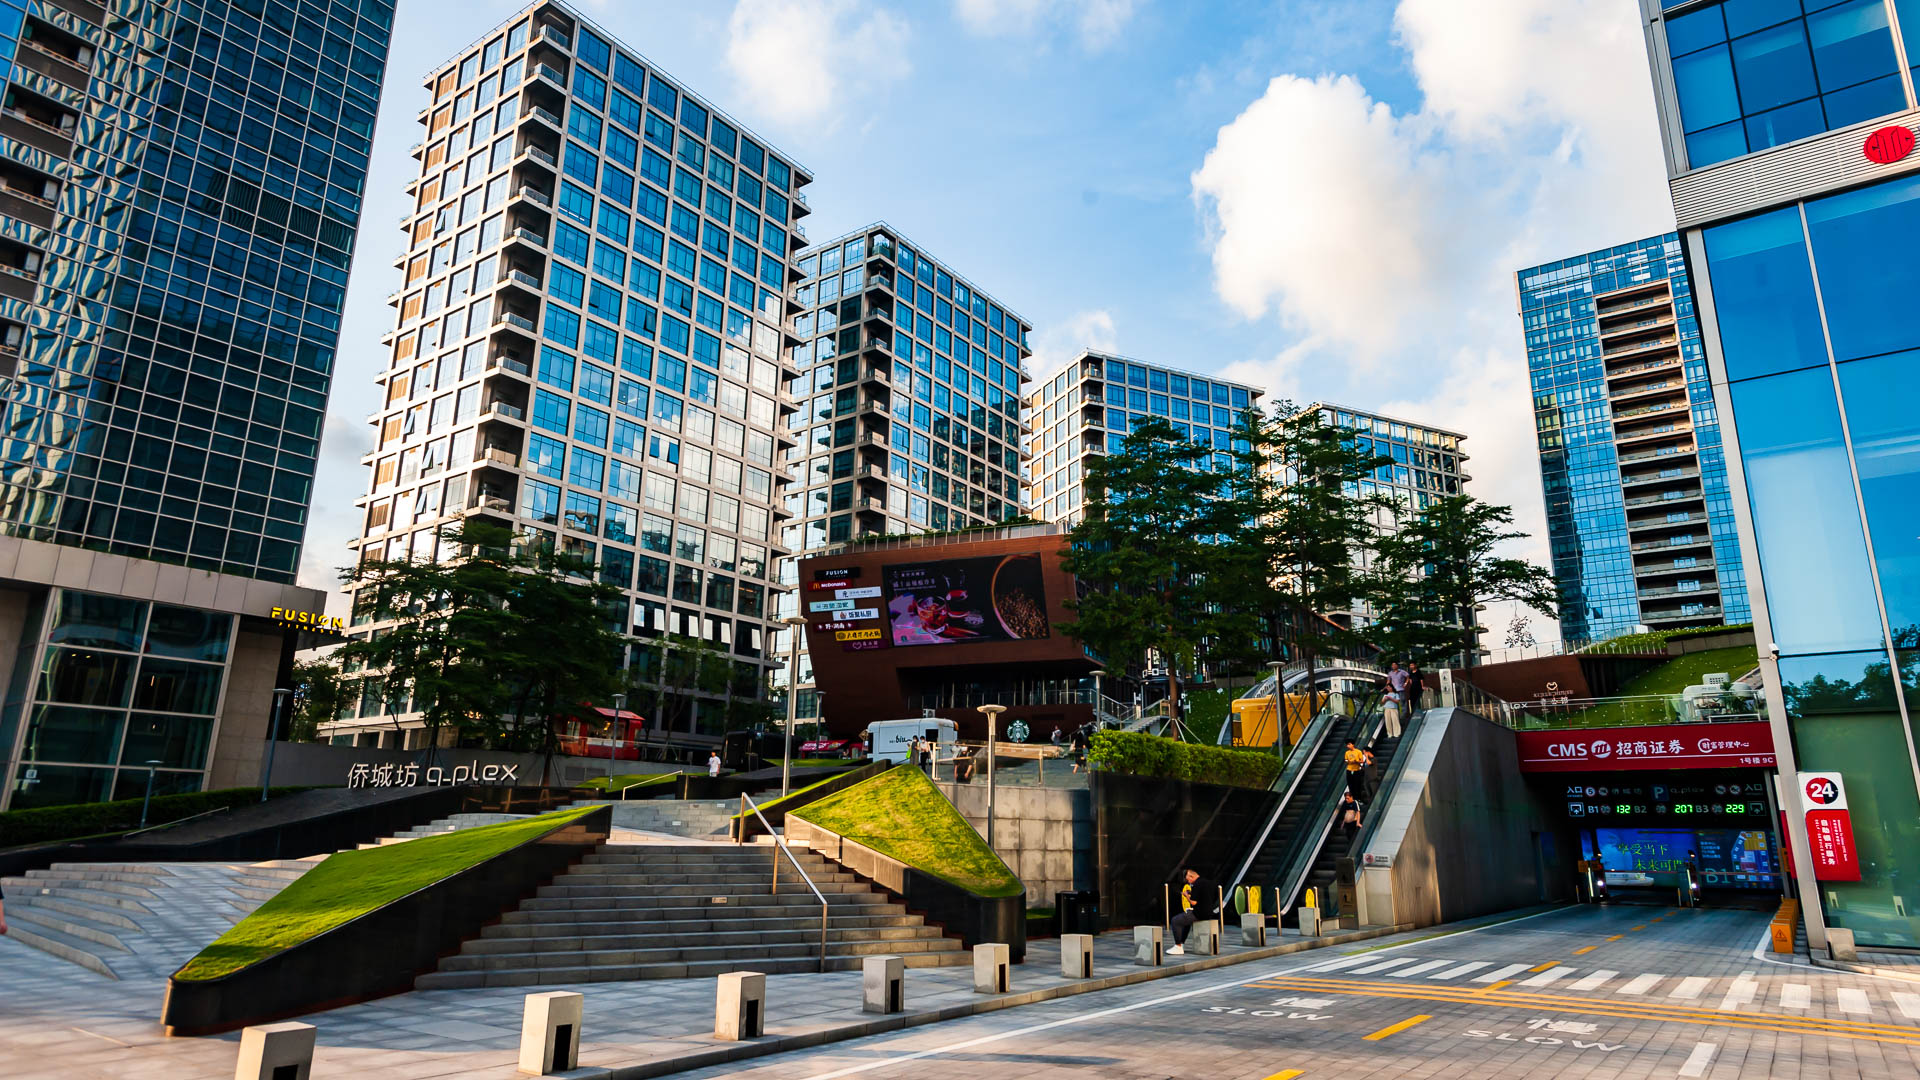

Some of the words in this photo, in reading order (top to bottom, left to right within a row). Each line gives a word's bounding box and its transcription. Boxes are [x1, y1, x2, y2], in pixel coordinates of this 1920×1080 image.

[271, 606, 343, 628] FUSION
[1548, 743, 1587, 757] CMS
[1615, 739, 1685, 756] 招商证券
[347, 761, 420, 789] 侨城坊
[1567, 786, 1583, 794] 入口
[1810, 782, 1835, 798] 24
[1588, 803, 1599, 814] B1
[1616, 804, 1631, 814] 132
[1634, 804, 1647, 814] B2
[1674, 804, 1693, 814] 207
[1695, 804, 1709, 813] B3
[1725, 804, 1745, 813] 229
[1704, 868, 1732, 884] B1
[1201, 1006, 1334, 1021] SLOW
[1462, 1029, 1627, 1051] SLOW
